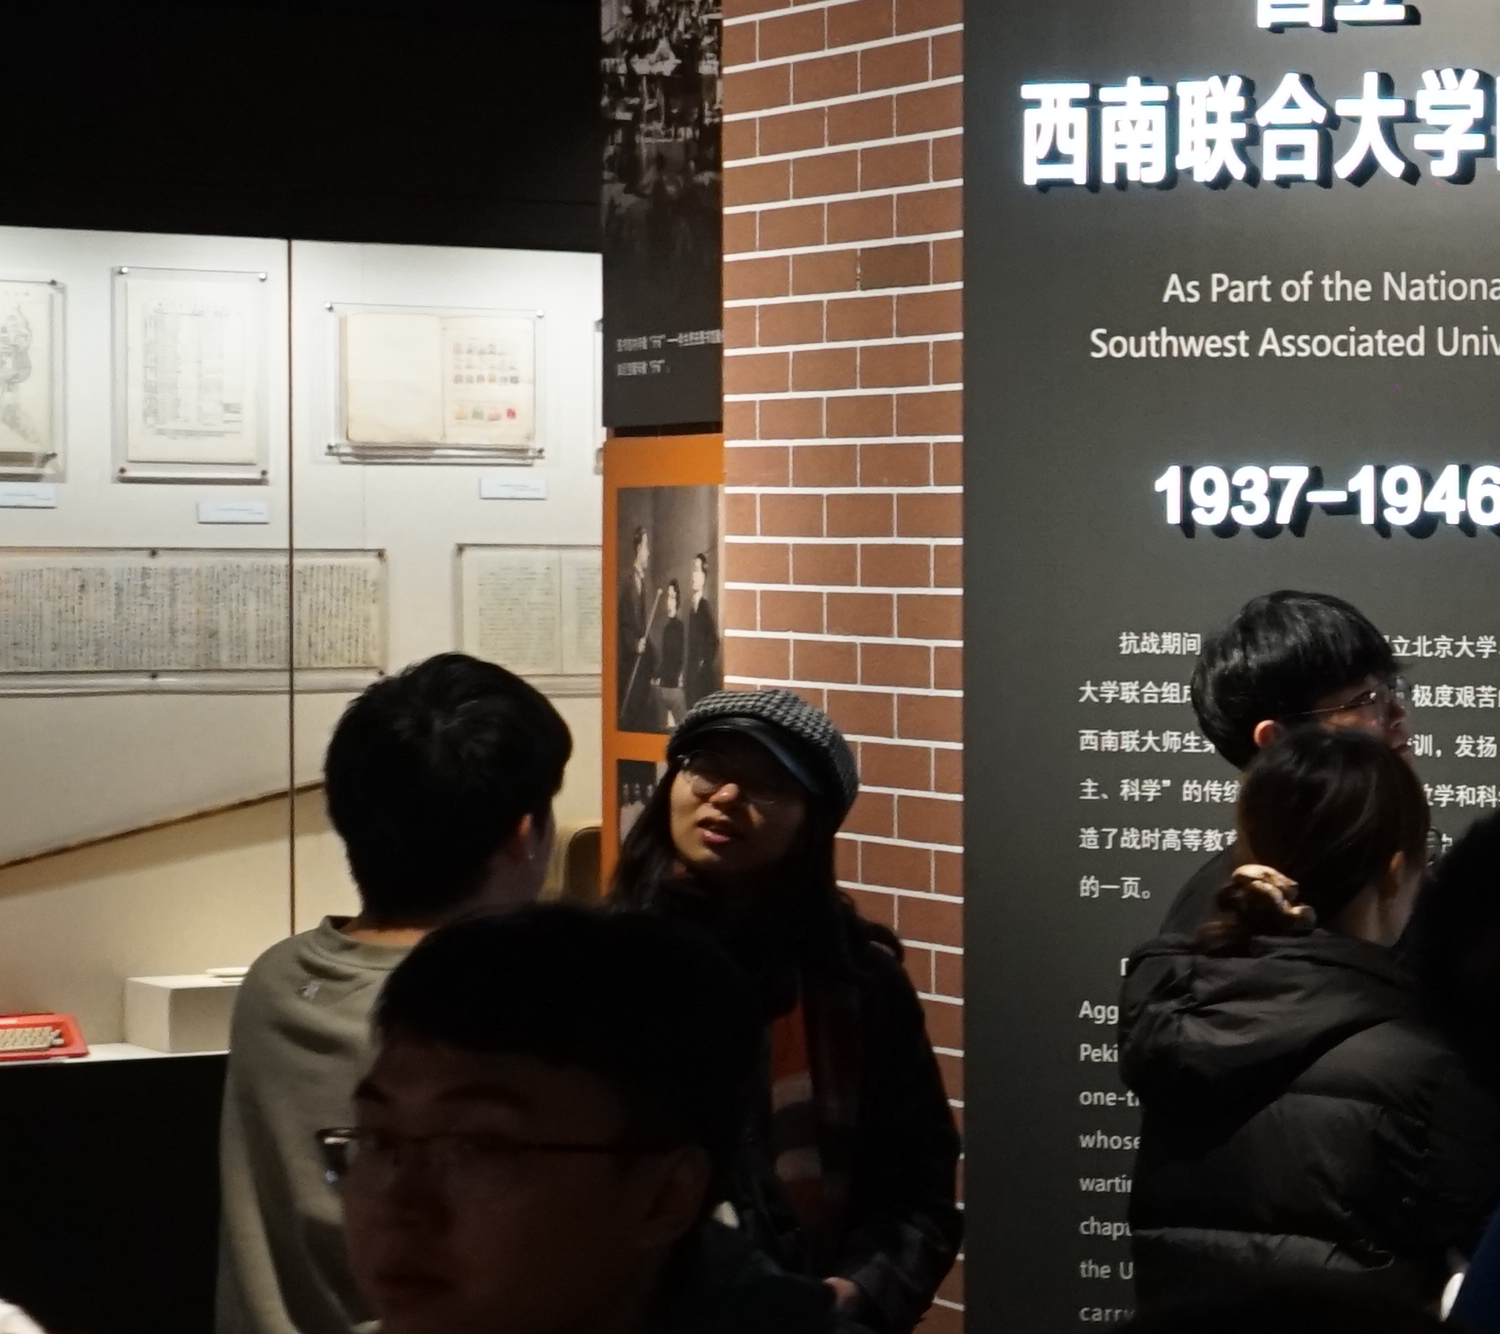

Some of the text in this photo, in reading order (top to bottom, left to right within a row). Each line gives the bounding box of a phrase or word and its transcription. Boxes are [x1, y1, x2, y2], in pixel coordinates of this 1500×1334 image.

[1162, 273, 1201, 304] As
[1210, 272, 1271, 304] Part
[1280, 271, 1313, 303] of
[1321, 271, 1372, 302] the
[1090, 328, 1249, 359] Southwest
[1259, 327, 1425, 358] Associated
[1119, 633, 1201, 655] 抗战期间
[1079, 876, 1153, 900] 的一页。
[1079, 1000, 1119, 1025] Agg
[1079, 1044, 1119, 1063] Peki
[1079, 1260, 1111, 1278] the
